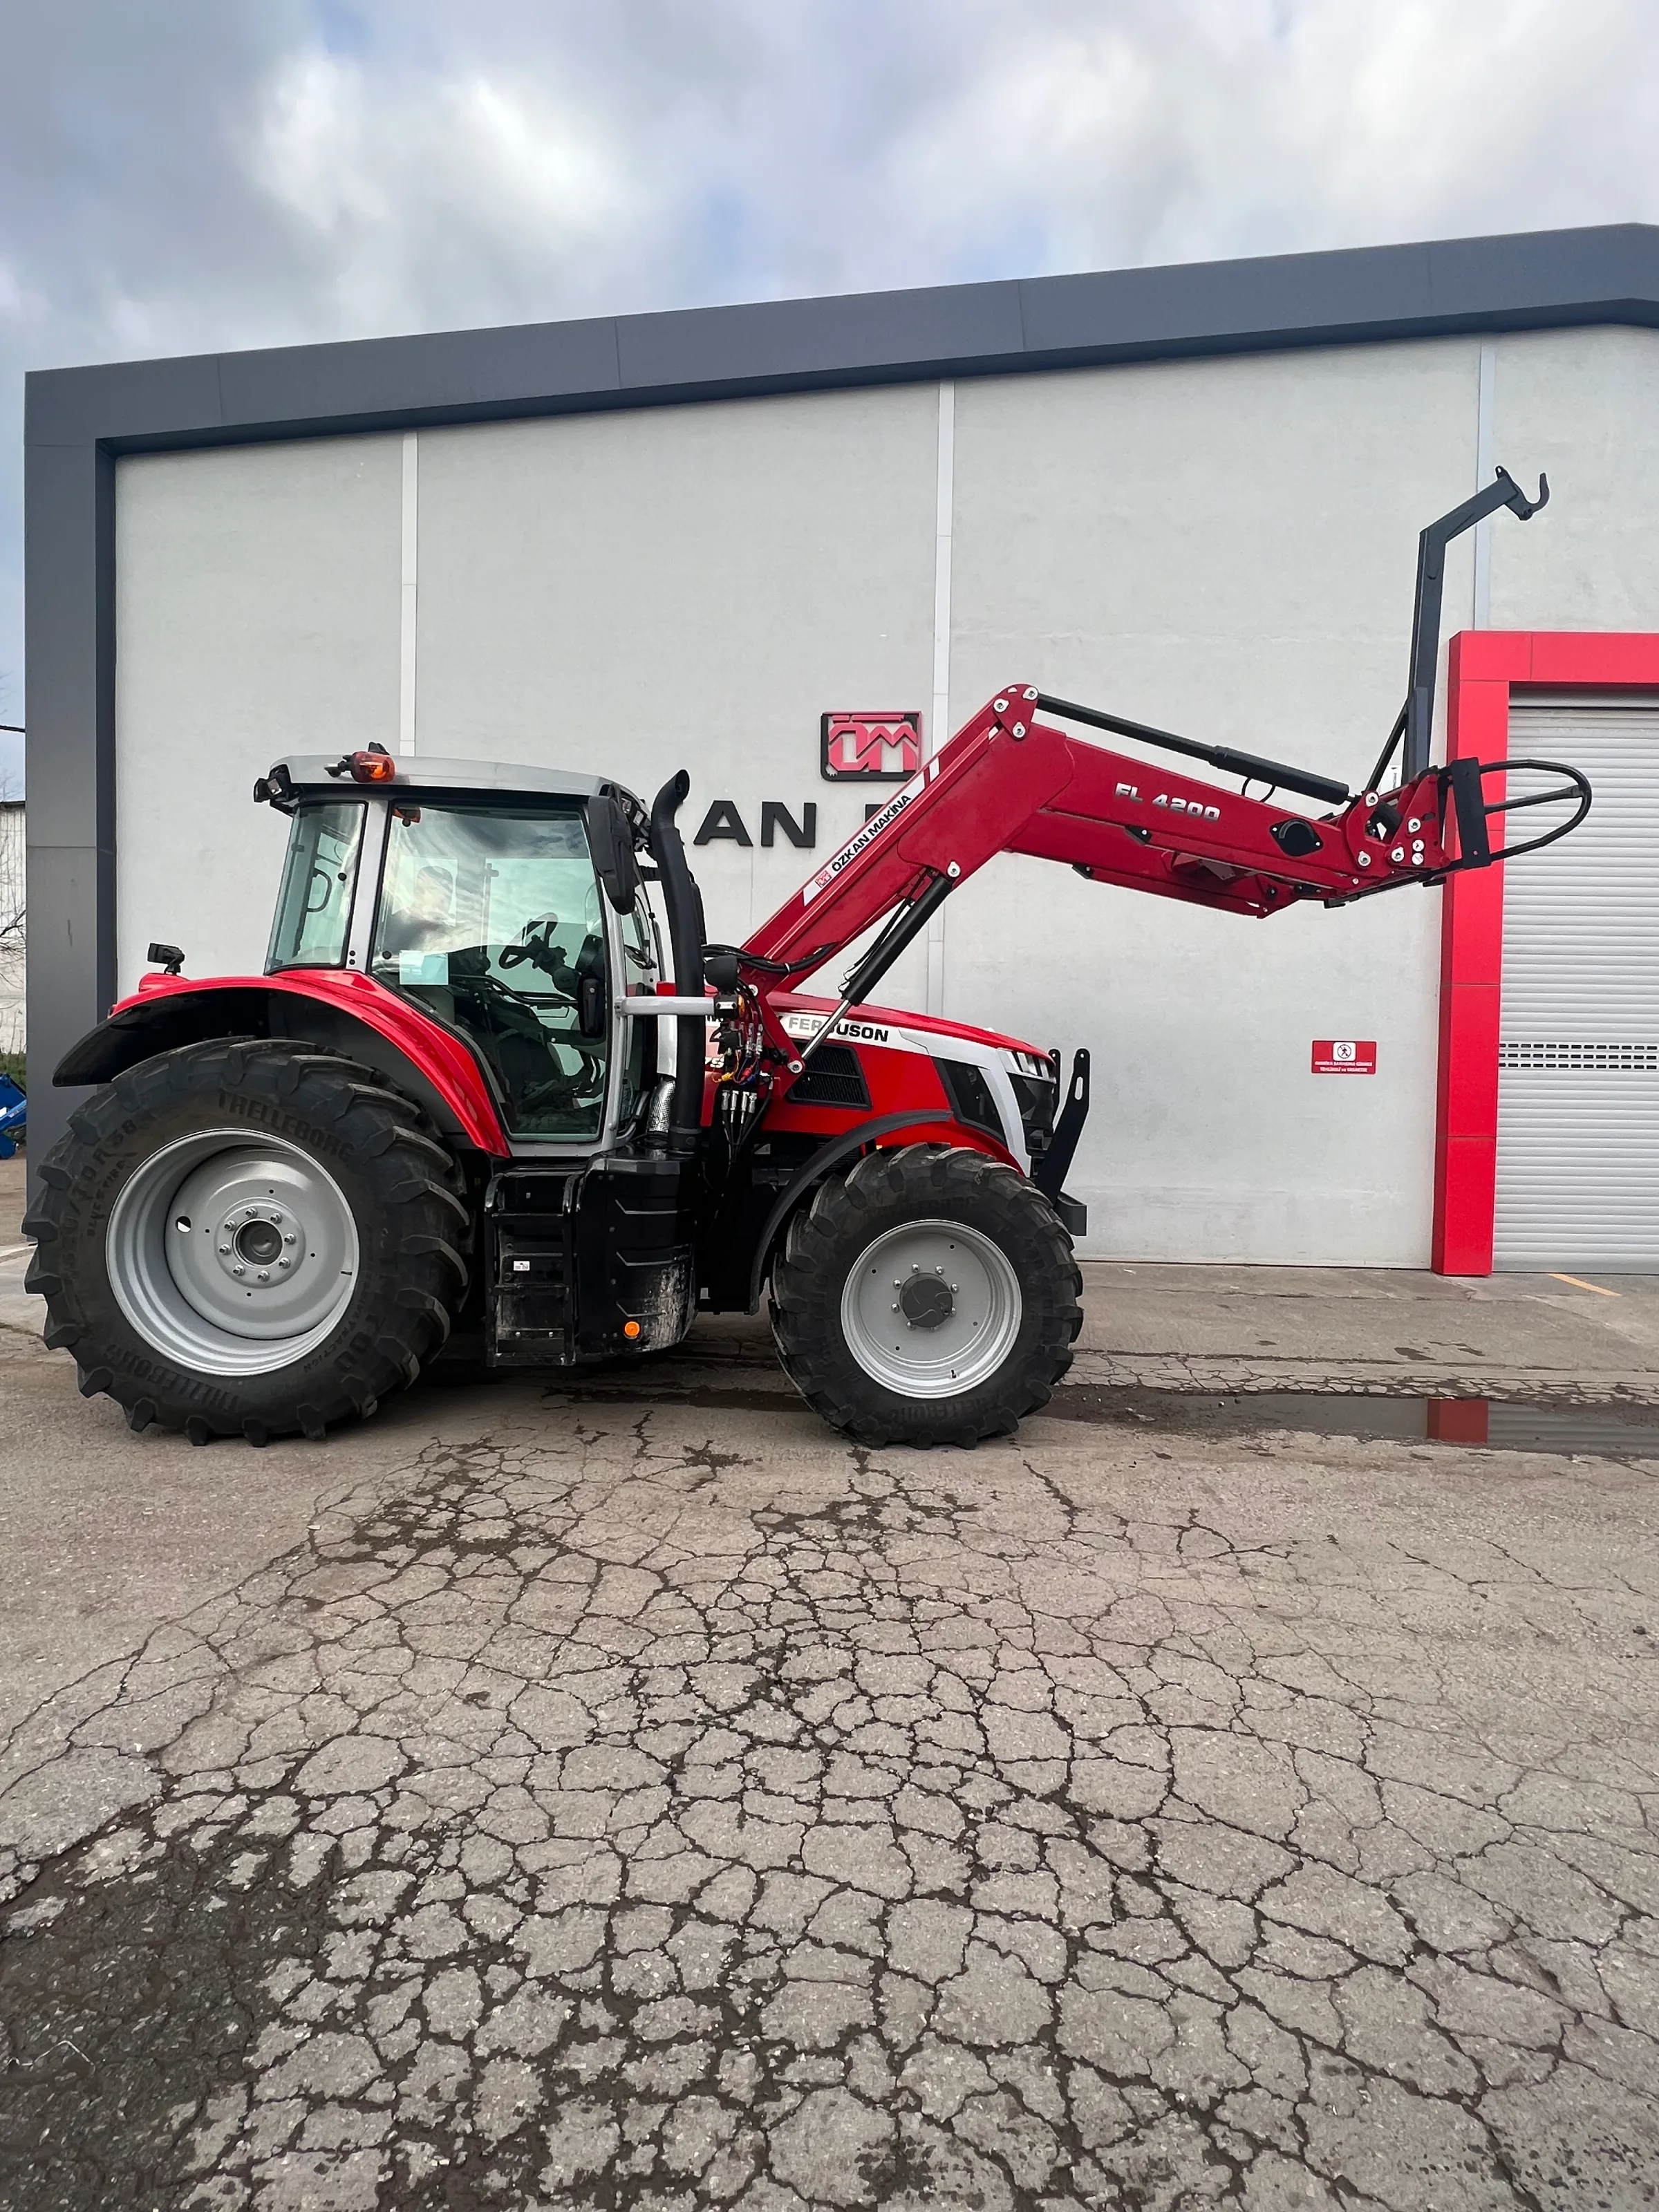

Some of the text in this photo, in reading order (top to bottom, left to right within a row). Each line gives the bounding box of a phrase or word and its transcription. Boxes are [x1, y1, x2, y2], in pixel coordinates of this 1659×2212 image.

[1115, 782, 1221, 821] FL 4200
[831, 834, 870, 872] ÖZKAN
[867, 795, 912, 837] MAKİNA
[788, 1017, 889, 1042] FERUSON
[218, 1087, 357, 1163] TRELLEBORG
